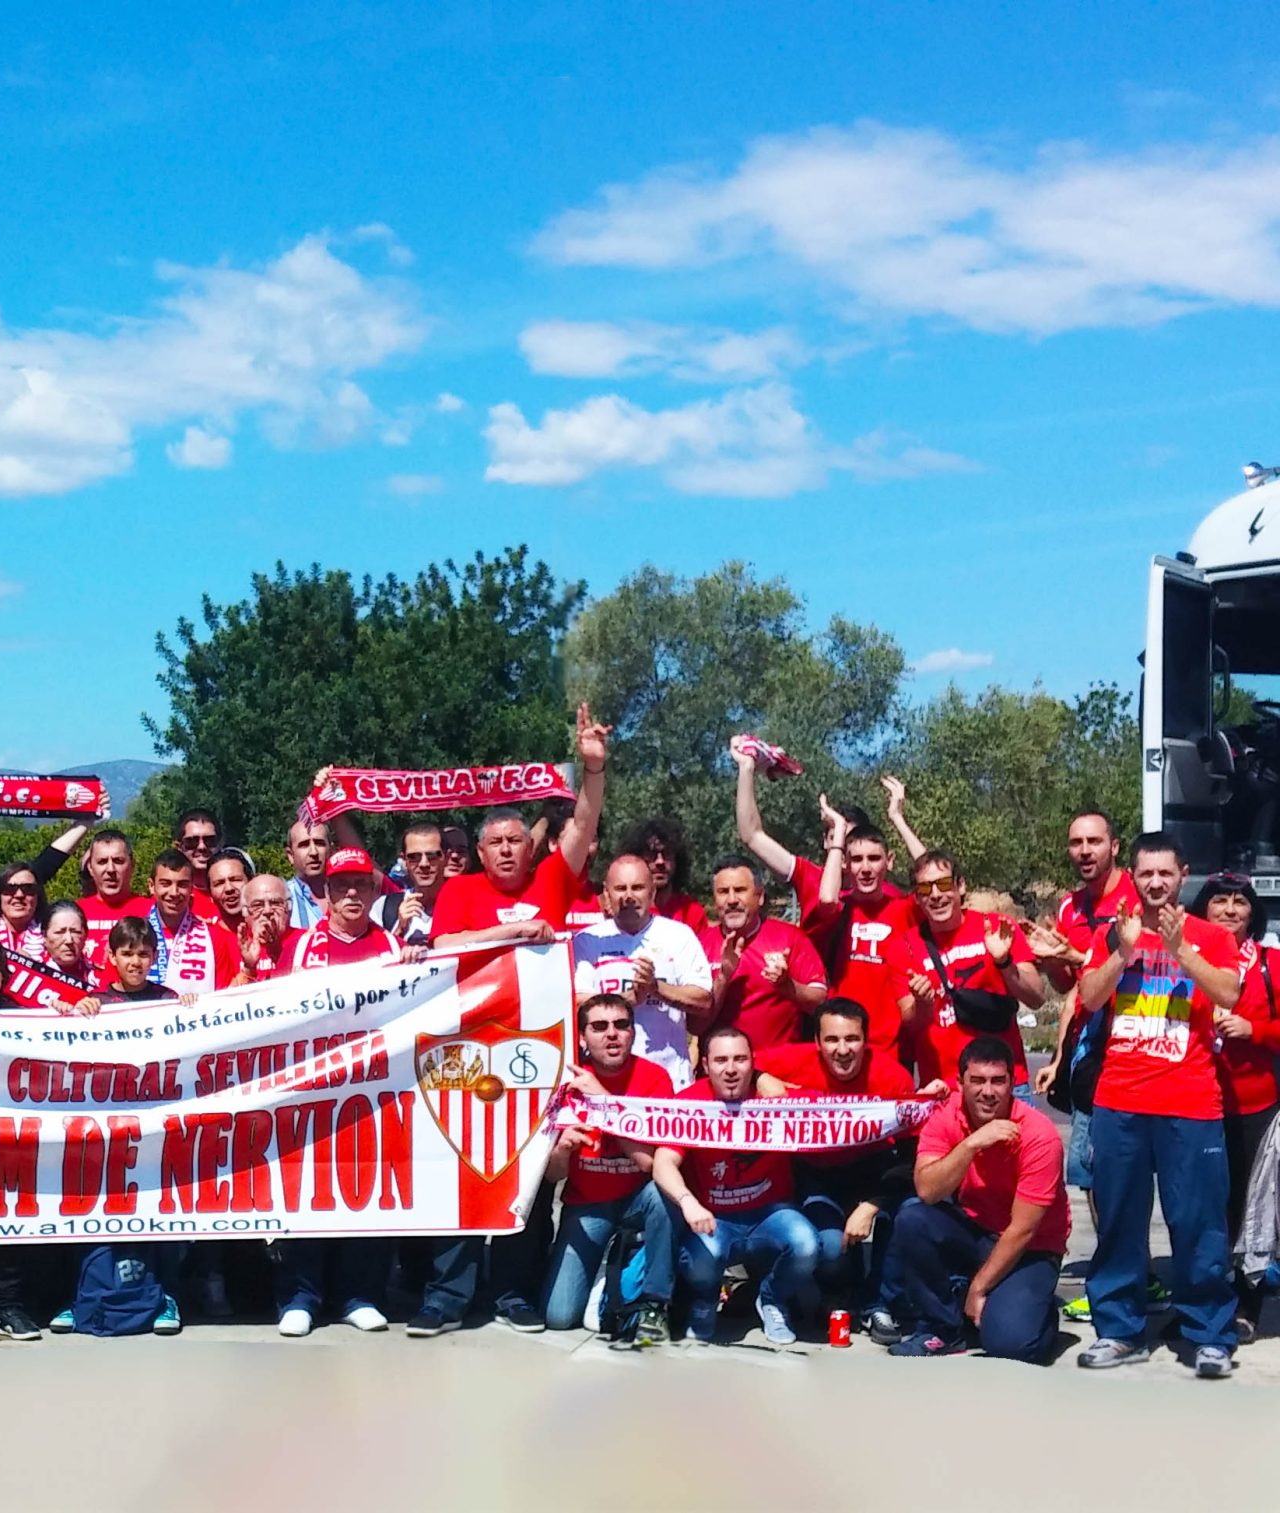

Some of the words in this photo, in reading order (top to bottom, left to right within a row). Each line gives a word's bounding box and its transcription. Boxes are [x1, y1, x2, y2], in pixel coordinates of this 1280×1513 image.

[356, 769, 475, 802] SEVILLA
[41, 1024, 155, 1042] superamos
[354, 987, 391, 1016] por
[8, 1057, 182, 1102] CULTURAL
[194, 1029, 390, 1101] SEVILLISTA
[58, 1114, 143, 1217] DE
[158, 1091, 417, 1215] NERVION
[620, 1113, 734, 1143] @1000KM
[744, 1119, 773, 1144] DE
[783, 1114, 884, 1146] NERVIÓN
